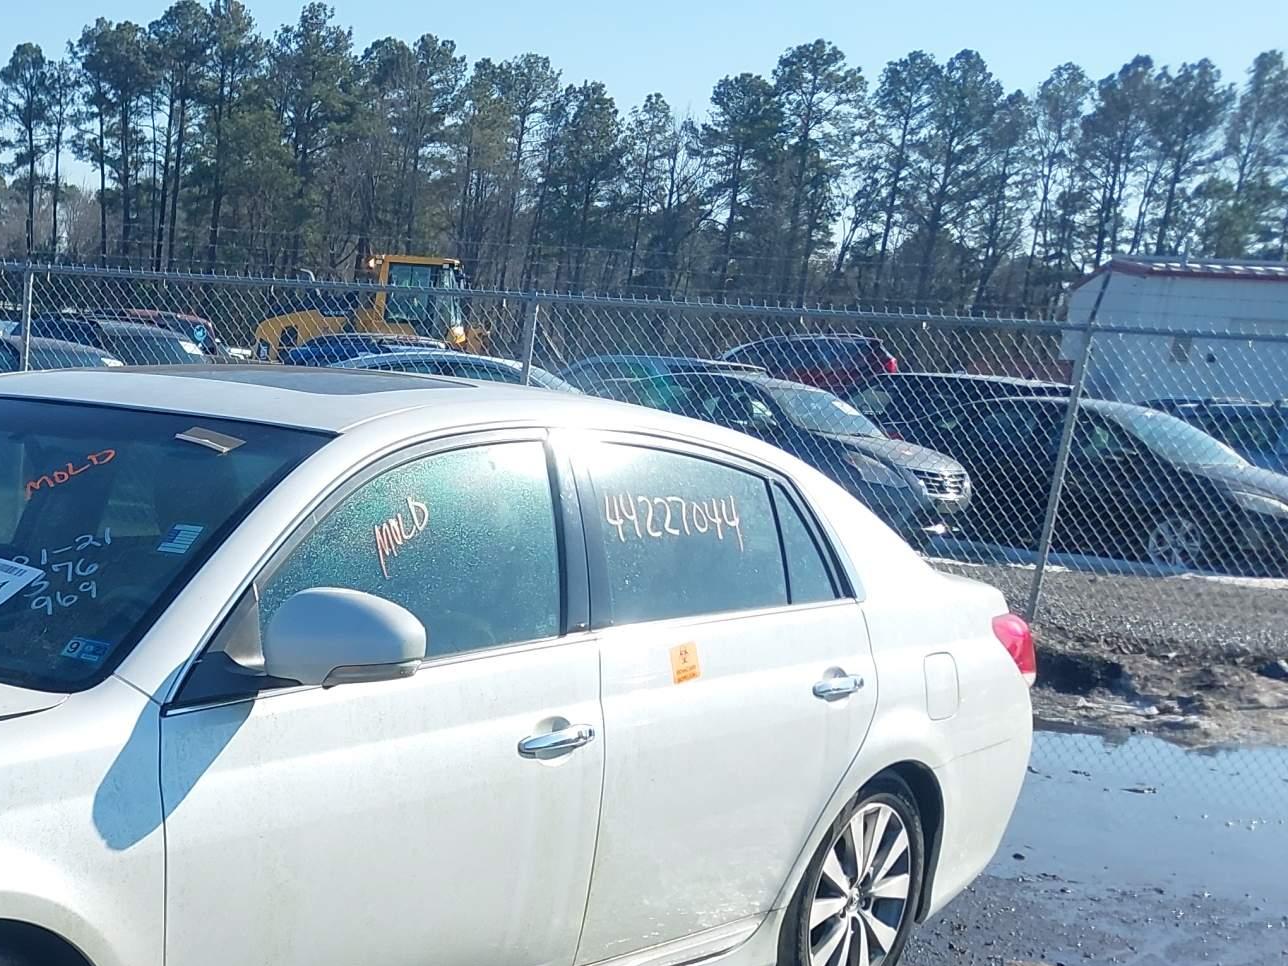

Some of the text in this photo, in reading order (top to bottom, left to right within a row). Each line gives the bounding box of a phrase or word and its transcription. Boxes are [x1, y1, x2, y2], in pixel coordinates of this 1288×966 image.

[24, 448, 116, 501] MOLD
[374, 496, 429, 579] MOLD
[604, 490, 744, 552] 44227044
[30, 580, 97, 615] 969
